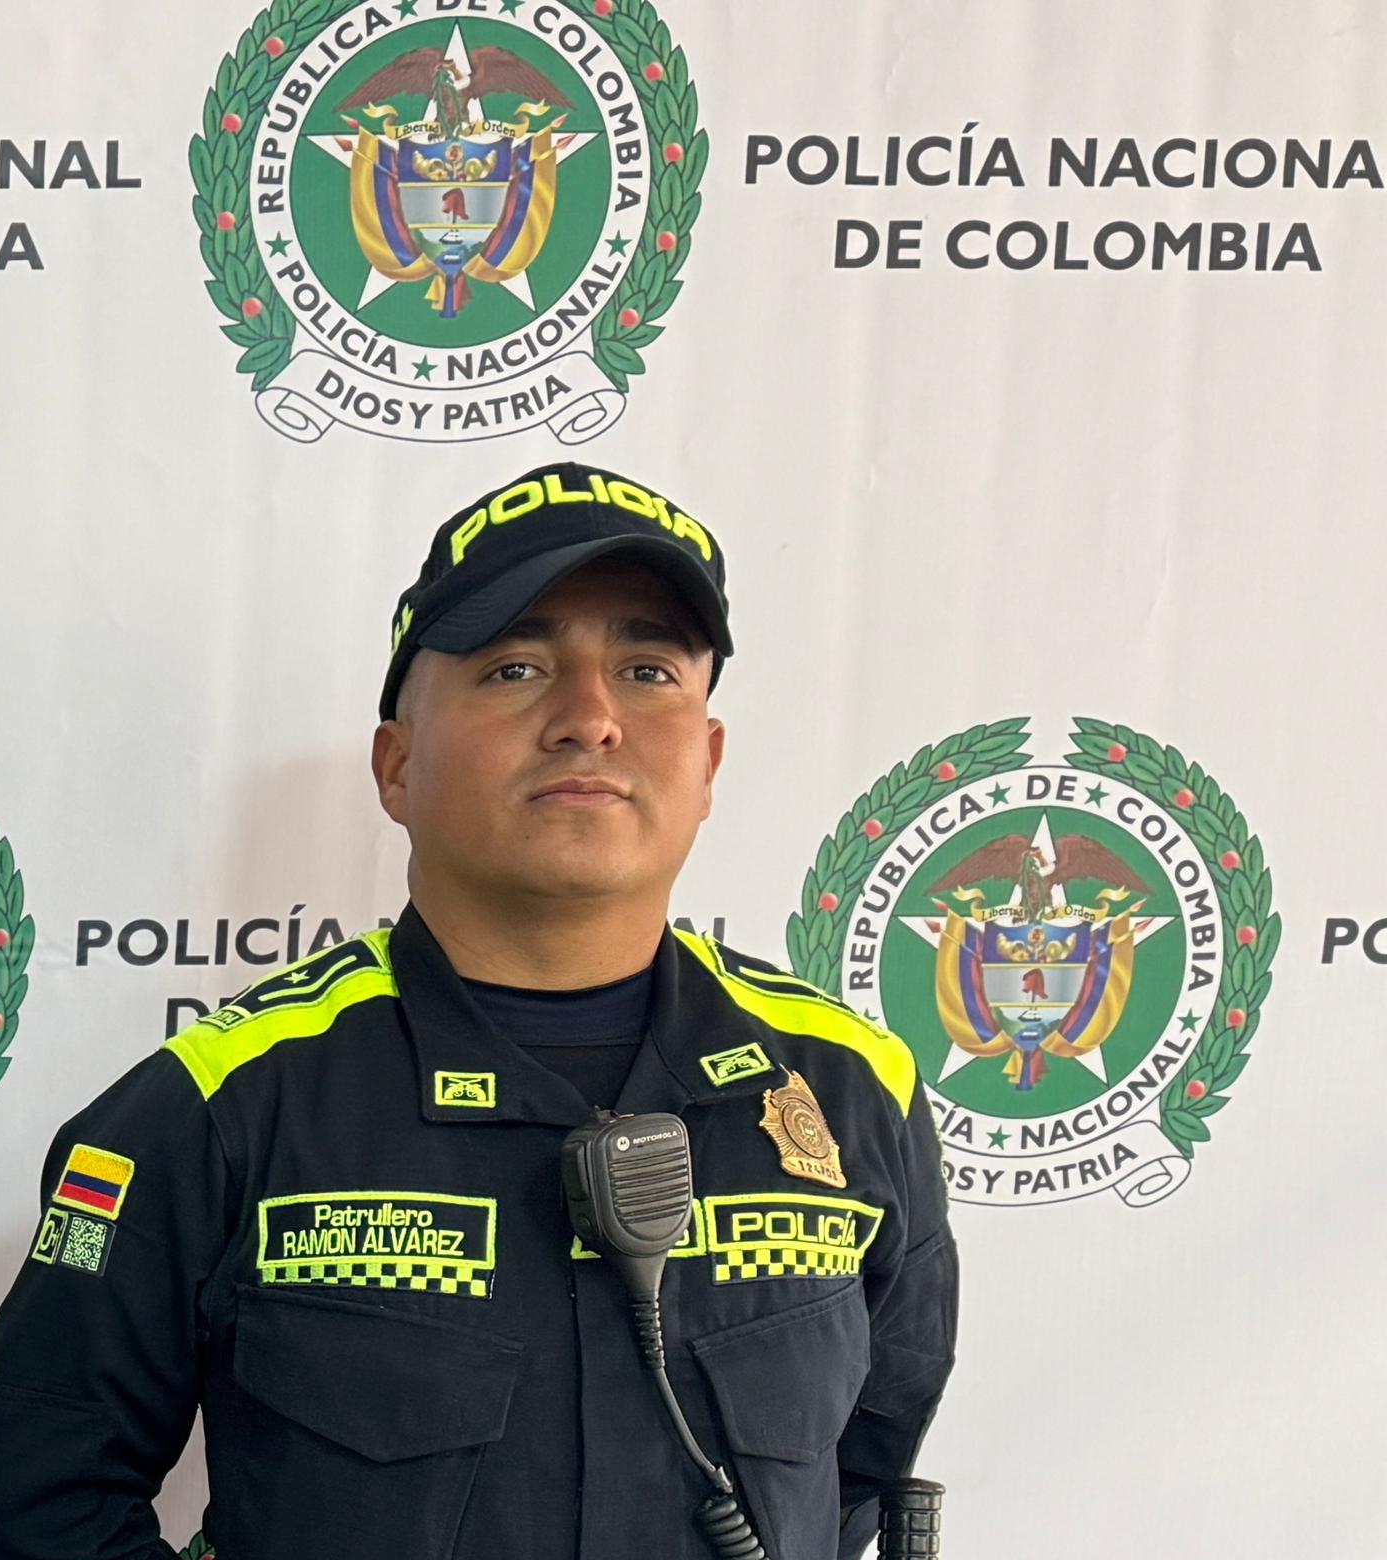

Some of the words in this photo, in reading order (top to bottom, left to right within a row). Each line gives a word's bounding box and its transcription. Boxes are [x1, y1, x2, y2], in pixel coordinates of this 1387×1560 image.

[257, 4, 395, 215] REPÚBLICA
[481, 120, 517, 139] Orden
[531, 4, 644, 214] COLOMBIA
[743, 121, 1026, 188] POLICÍA
[832, 219, 925, 271] DE
[944, 219, 1323, 273] COLOMBIA
[275, 259, 399, 376] POLICÍA
[446, 257, 625, 382] NACIONAL
[313, 368, 405, 425] DIOS
[408, 400, 432, 430] Y
[442, 373, 573, 430] PATRIA
[450, 473, 713, 567] POLICÍA
[847, 792, 984, 991] REPÚBLICA
[1025, 774, 1078, 801] DE
[1116, 796, 1217, 992] COLOMBIA
[1063, 904, 1097, 922] Orden
[1019, 1029, 1192, 1150] NACIONAL
[979, 1166, 1005, 1195] Y
[1012, 1140, 1139, 1195] PATRIA
[314, 1202, 434, 1229] Patrullero
[361, 1226, 465, 1257] ALVAREZ
[731, 1210, 857, 1247] POLICÍA
